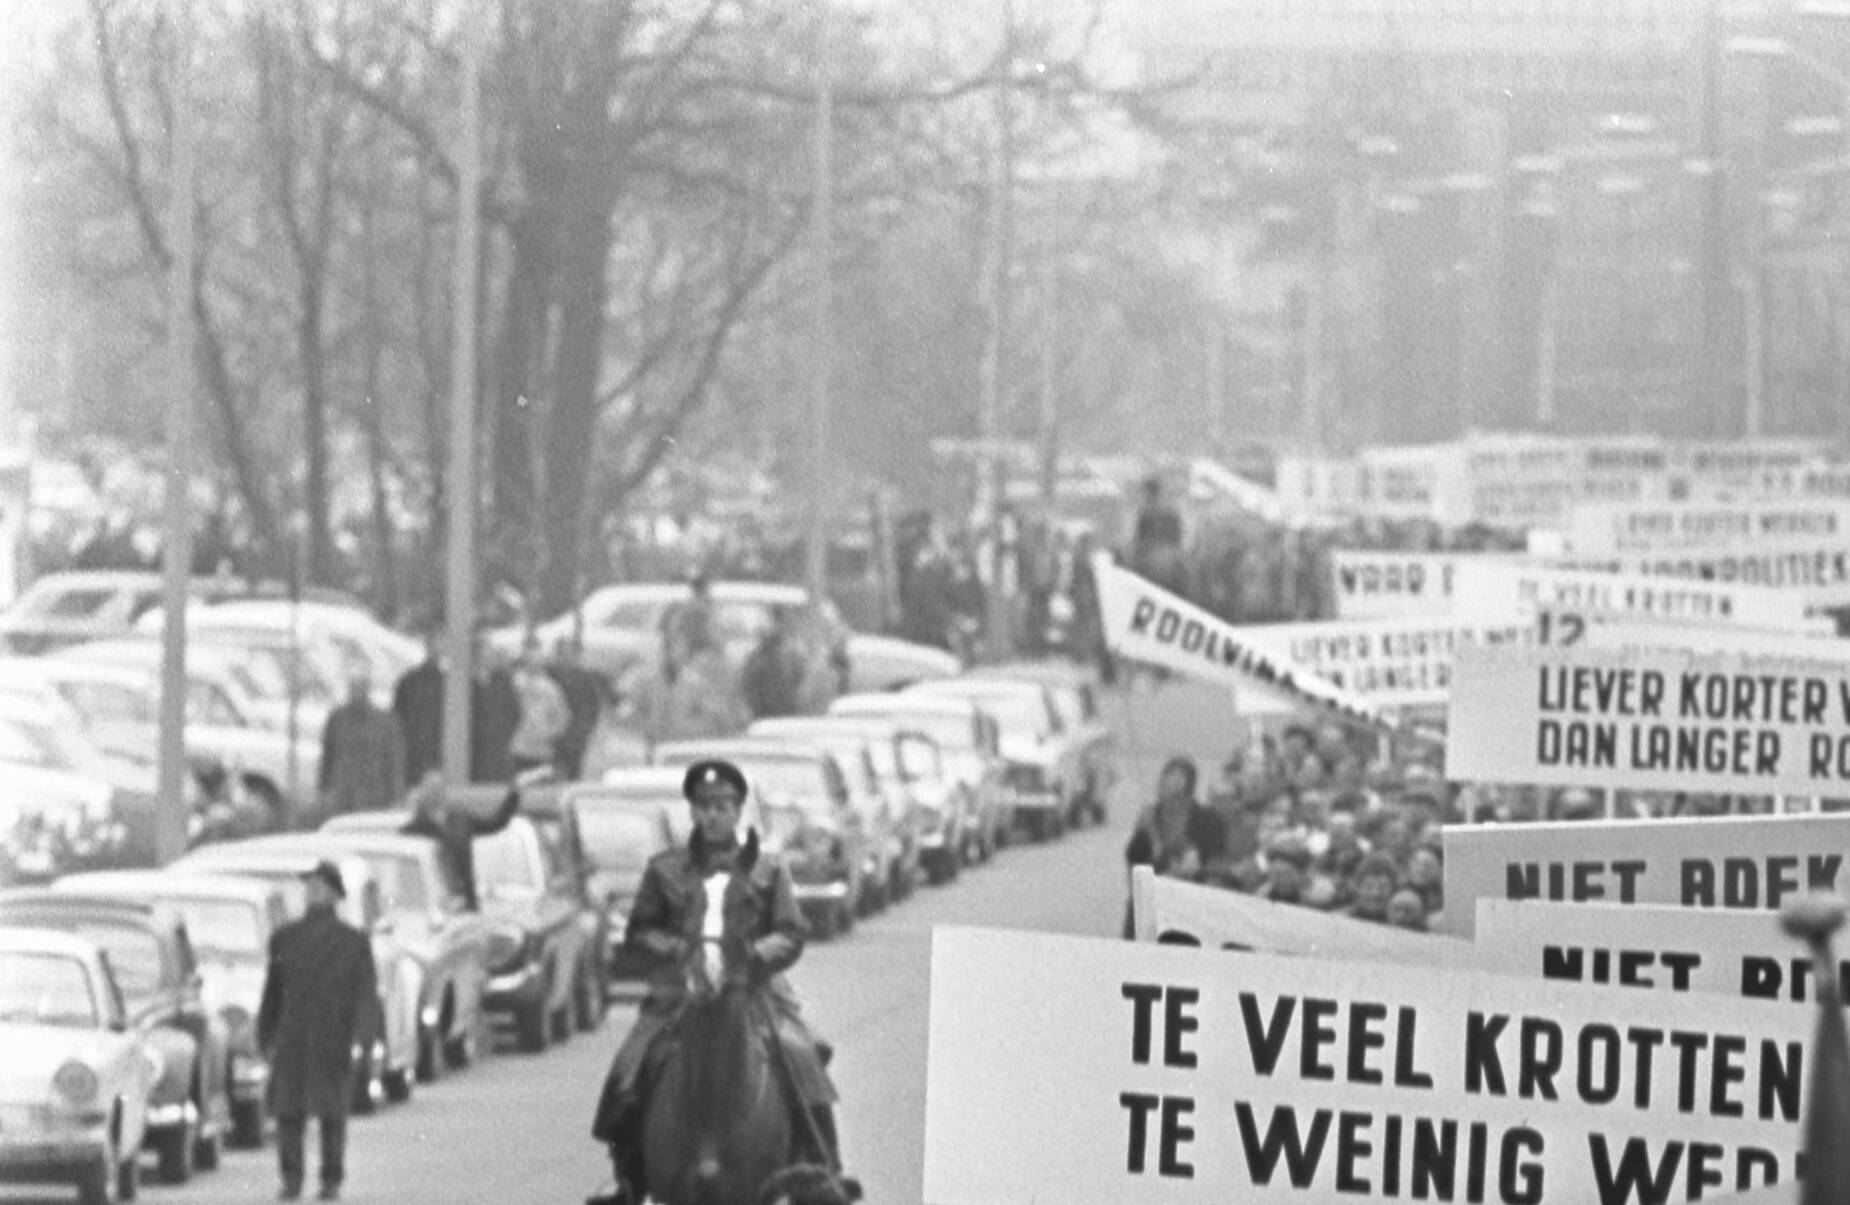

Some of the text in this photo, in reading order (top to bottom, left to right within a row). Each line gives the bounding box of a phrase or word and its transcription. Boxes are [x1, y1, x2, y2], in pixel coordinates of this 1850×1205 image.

[1538, 664, 1664, 716] LIEVER
[1679, 672, 1827, 724] KORTER
[1537, 718, 1617, 767] DAN
[1631, 714, 1781, 776] LANGER
[1122, 984, 1802, 1122] TE VEEL KROTTEN
[1120, 1093, 1196, 1178] TE
